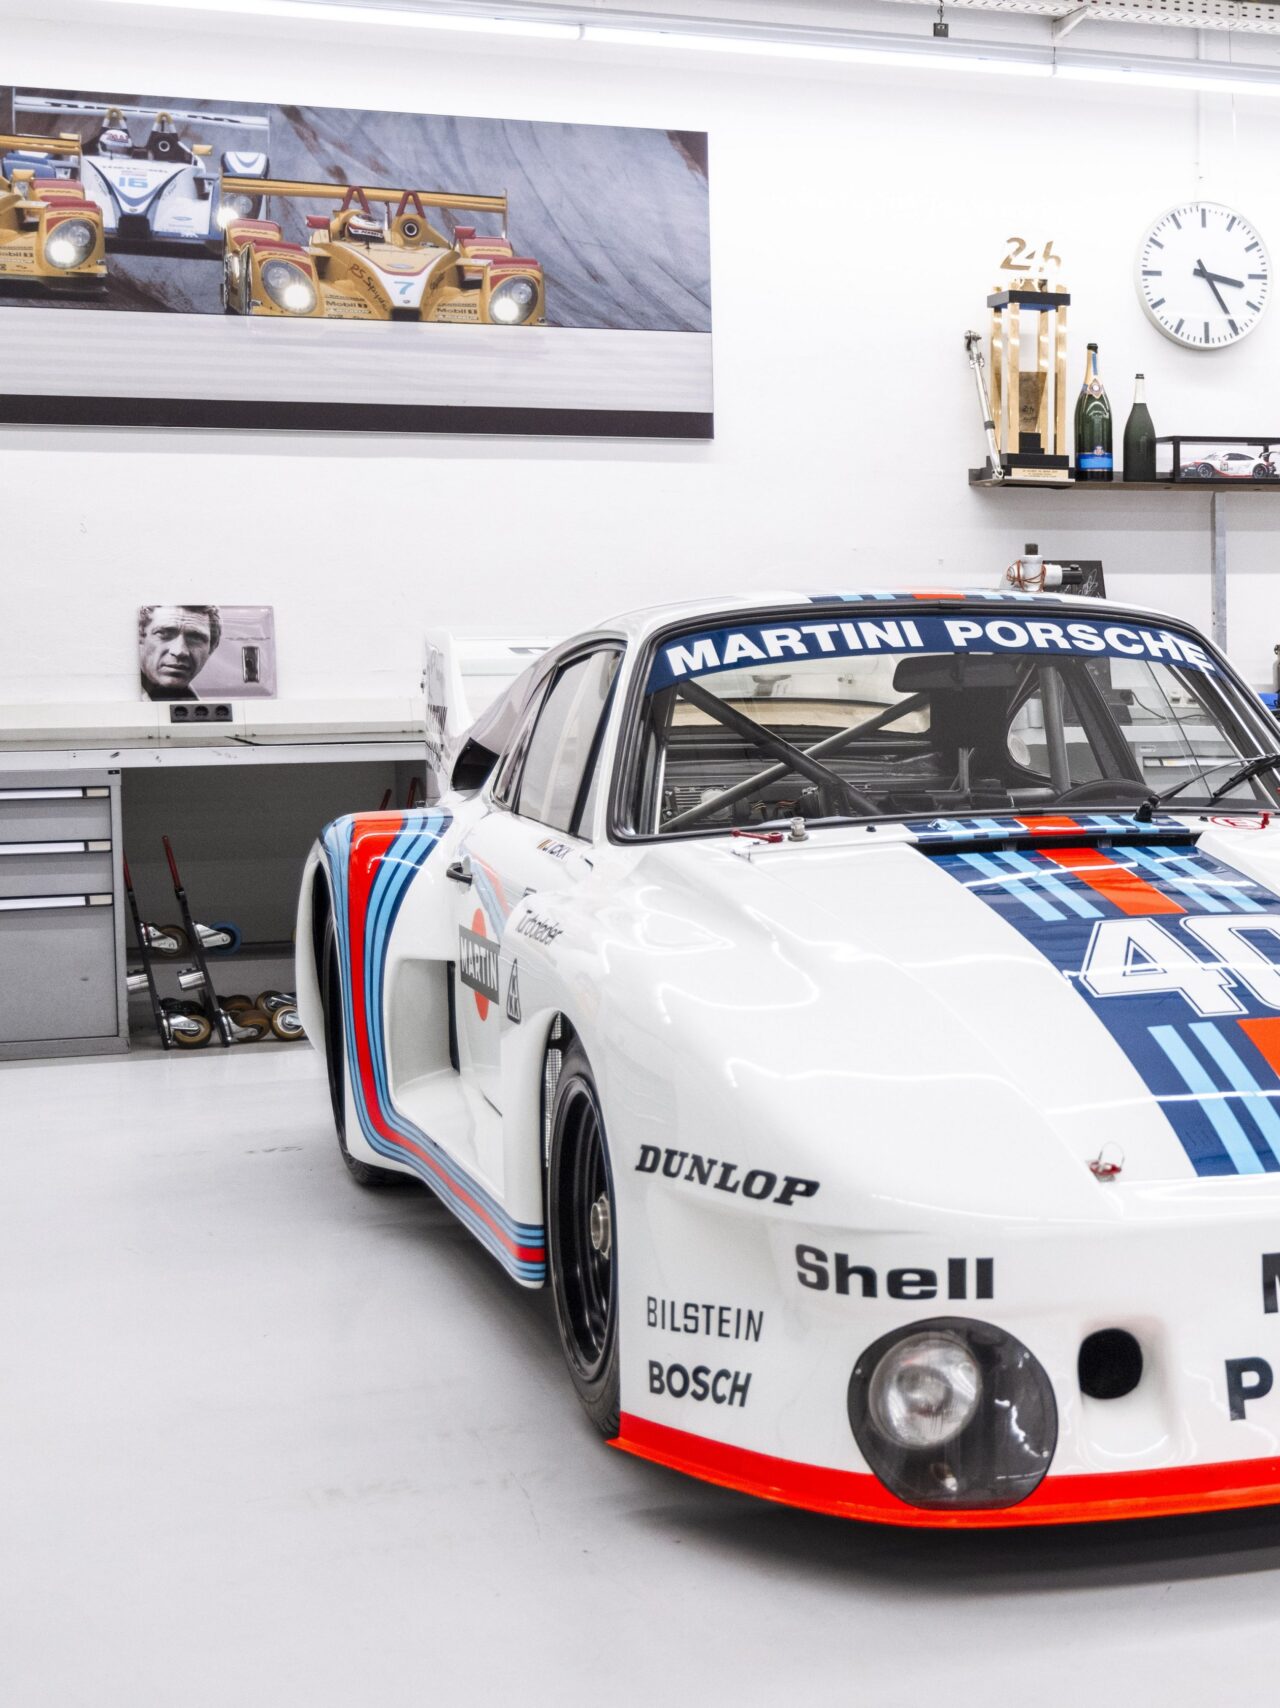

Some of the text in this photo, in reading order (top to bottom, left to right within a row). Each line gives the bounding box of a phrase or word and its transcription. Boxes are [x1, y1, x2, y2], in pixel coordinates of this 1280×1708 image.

[393, 281, 414, 295] 7
[666, 620, 1216, 676] MARTINI PORSCHE
[460, 935, 498, 992] MARTIN
[636, 1143, 820, 1206] DUNLOP
[795, 1243, 994, 1301] Shell
[646, 1296, 764, 1343] BILSTEIN
[648, 1360, 753, 1408] BOSCH
